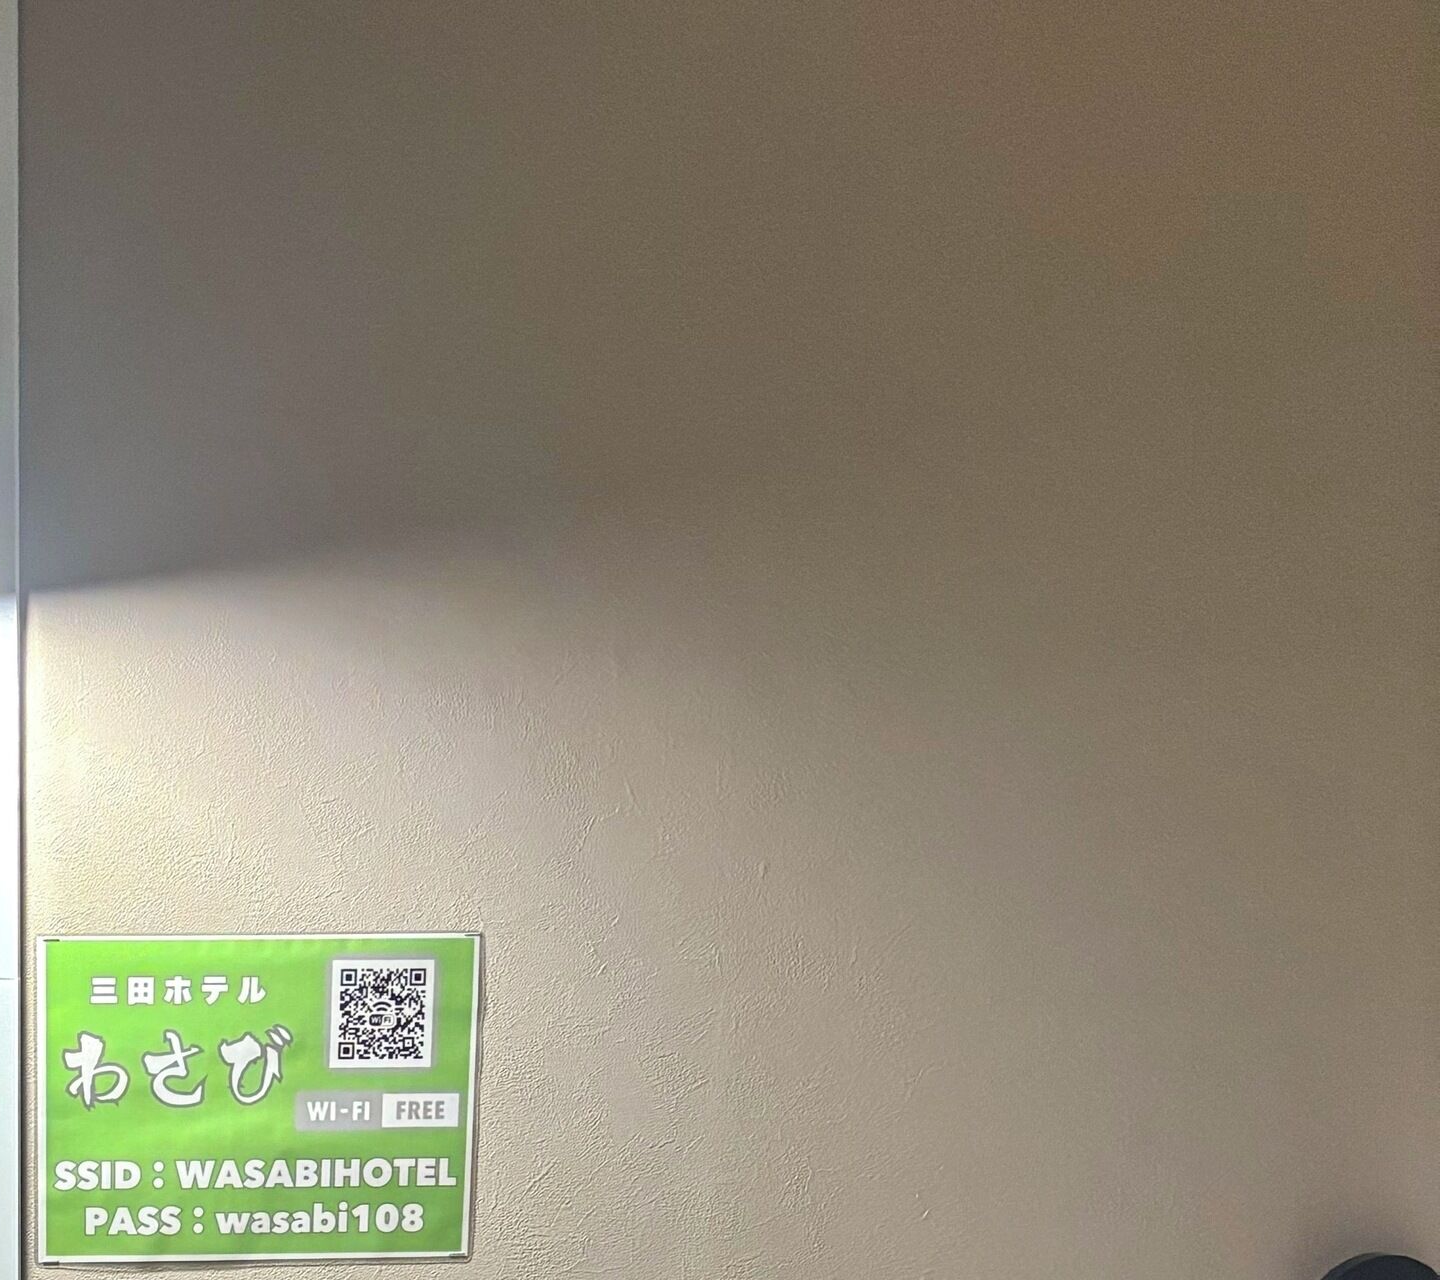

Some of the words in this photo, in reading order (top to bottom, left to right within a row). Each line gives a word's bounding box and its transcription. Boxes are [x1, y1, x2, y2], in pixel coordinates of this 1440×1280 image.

[88, 976, 267, 1006] 三田ホテル
[62, 1023, 294, 1111] わさび
[306, 1100, 371, 1121] WI-FI
[395, 1100, 446, 1120] FREE
[175, 1157, 458, 1189] WASABIHOTEL
[216, 1202, 425, 1234] wasabi108
